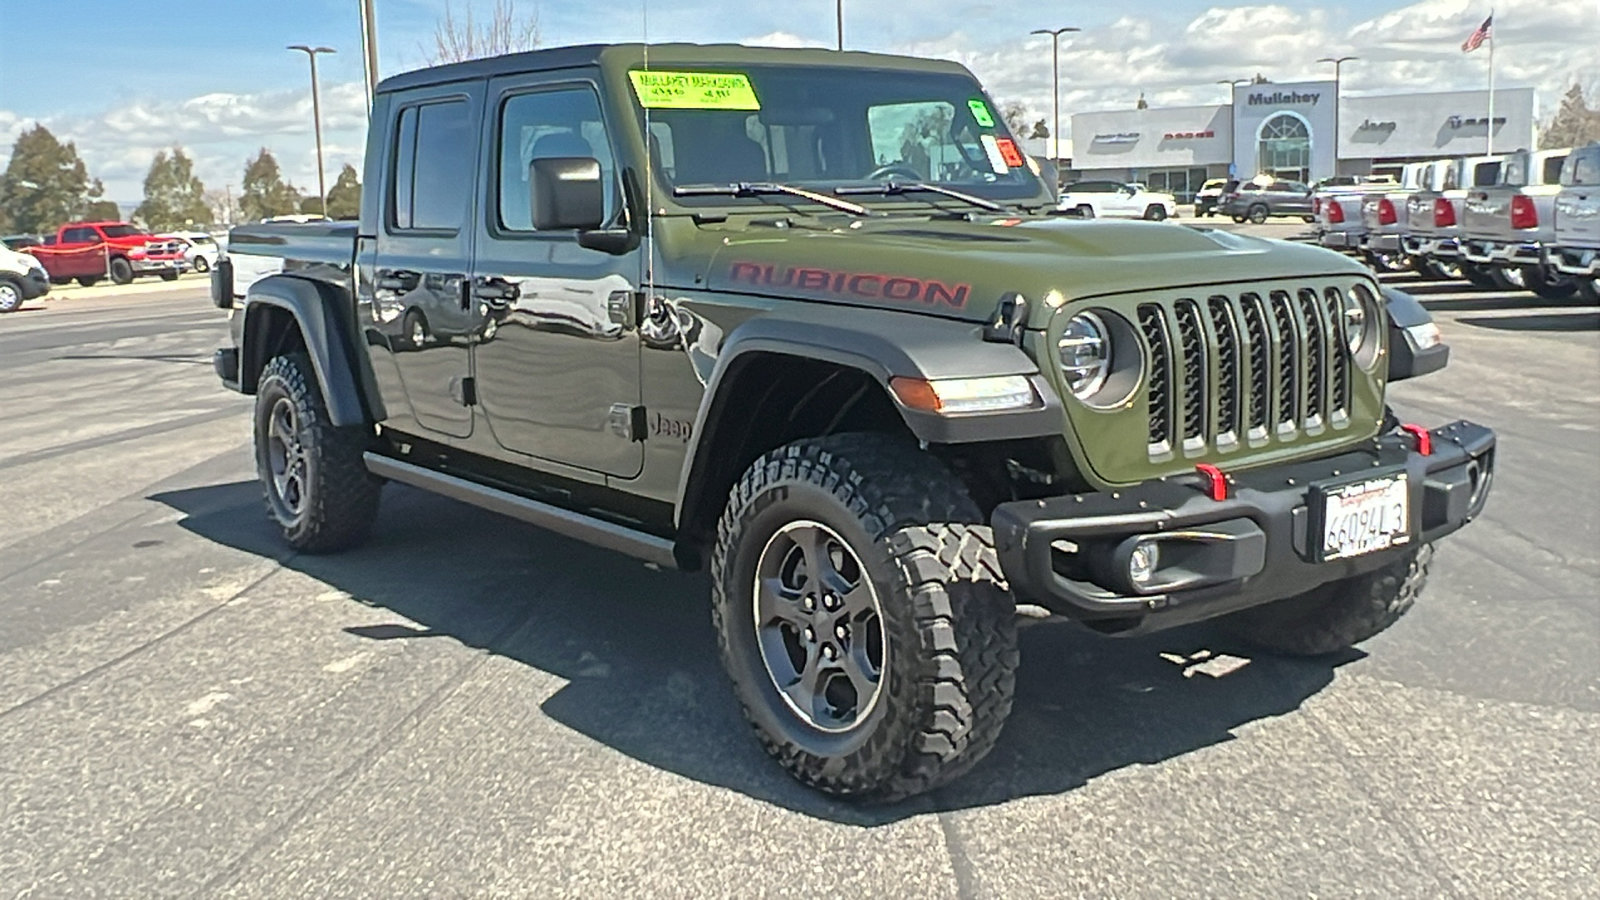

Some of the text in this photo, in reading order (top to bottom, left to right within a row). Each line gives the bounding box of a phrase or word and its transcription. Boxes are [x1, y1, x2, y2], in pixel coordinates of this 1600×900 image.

[1248, 91, 1320, 105] Mullahey
[729, 262, 971, 310] RUBICON
[650, 412, 693, 443] Jeep
[1327, 503, 1403, 548] 66094L3
